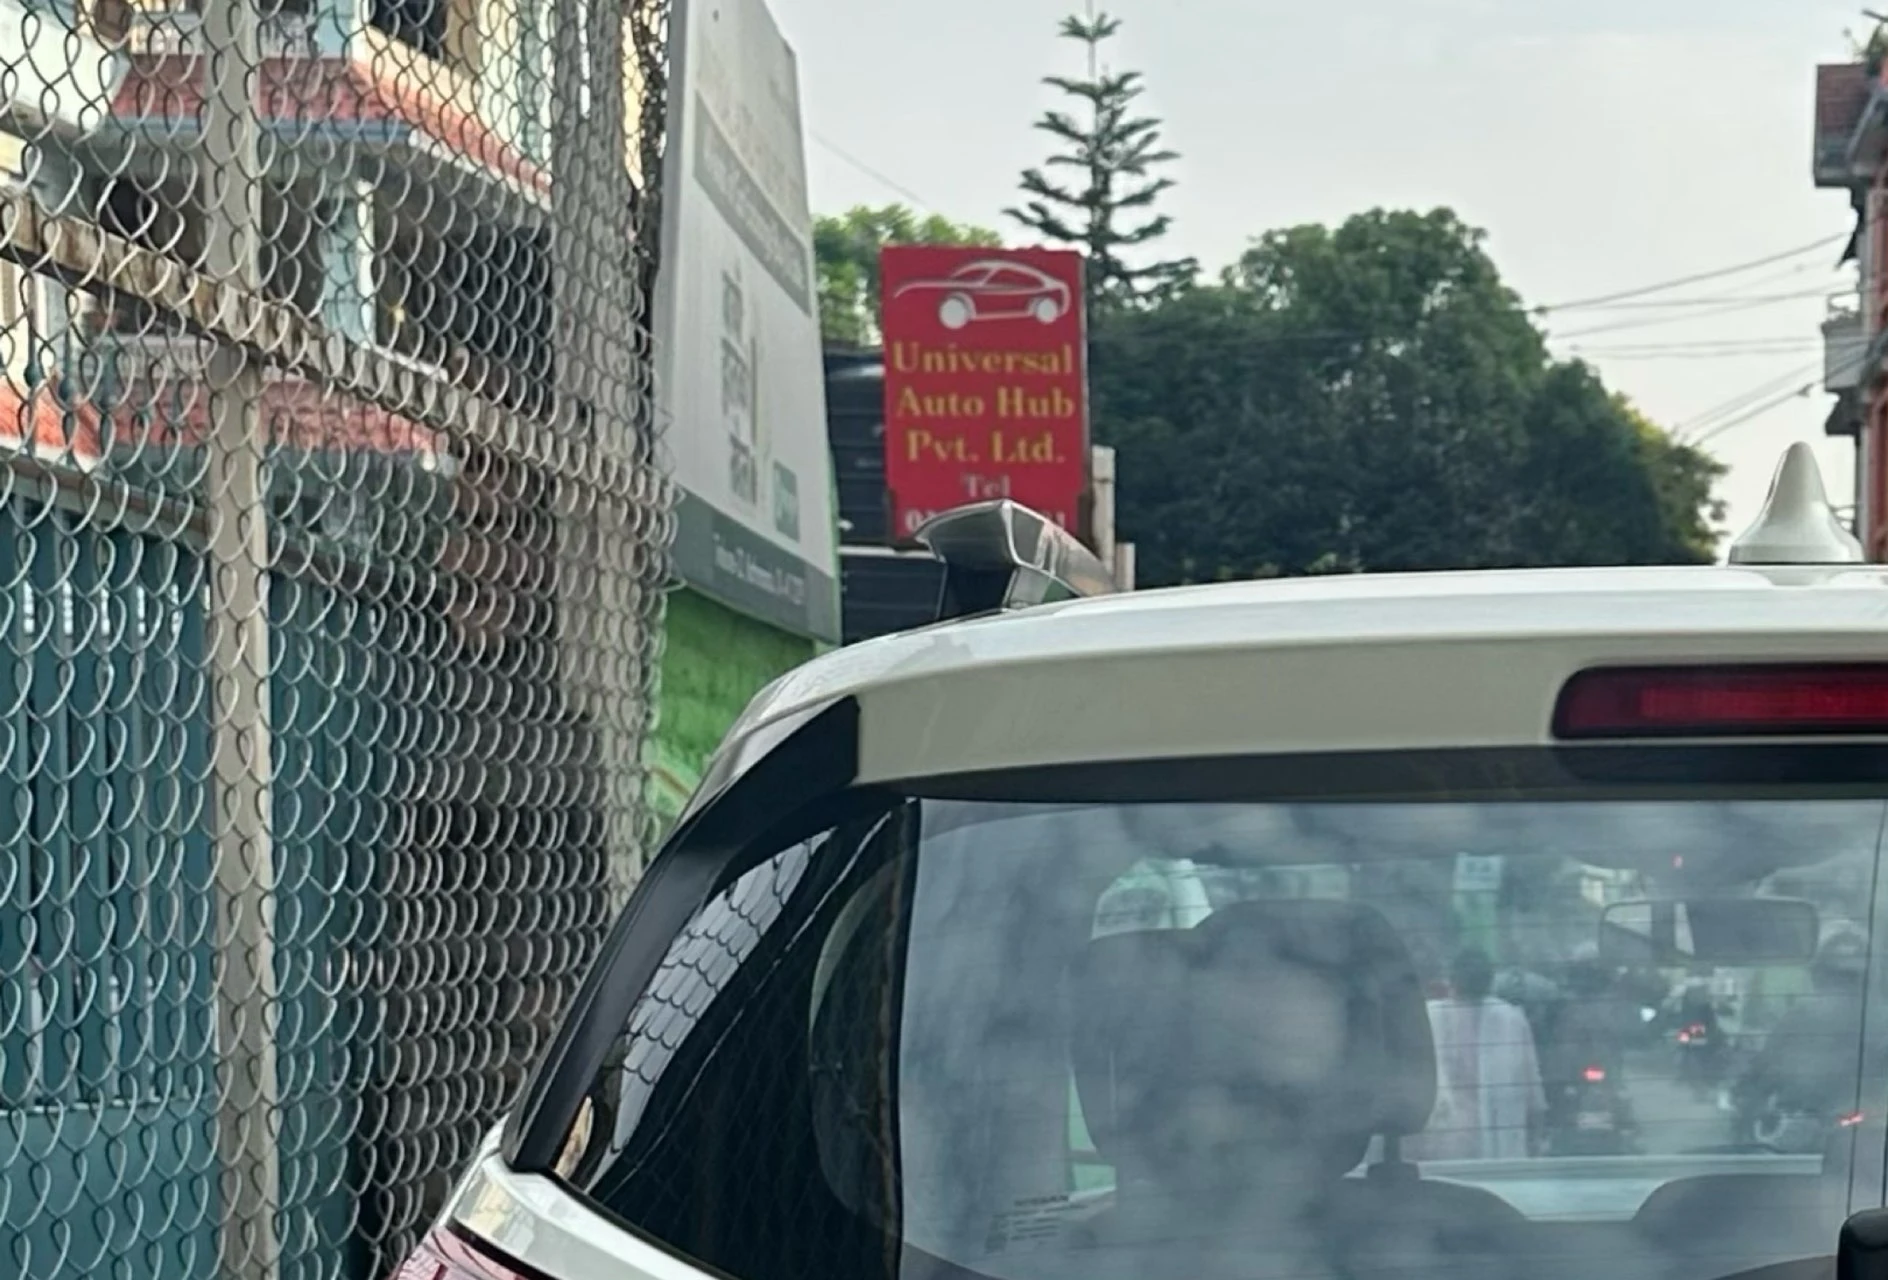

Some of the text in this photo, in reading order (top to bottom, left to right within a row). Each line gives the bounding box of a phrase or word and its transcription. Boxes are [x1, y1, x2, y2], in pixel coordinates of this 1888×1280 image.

[893, 342, 1073, 374] Universal
[898, 386, 1076, 418] Auto Hub
[907, 429, 1066, 463] Pvt. Ltd.
[962, 474, 1011, 498] Tel
